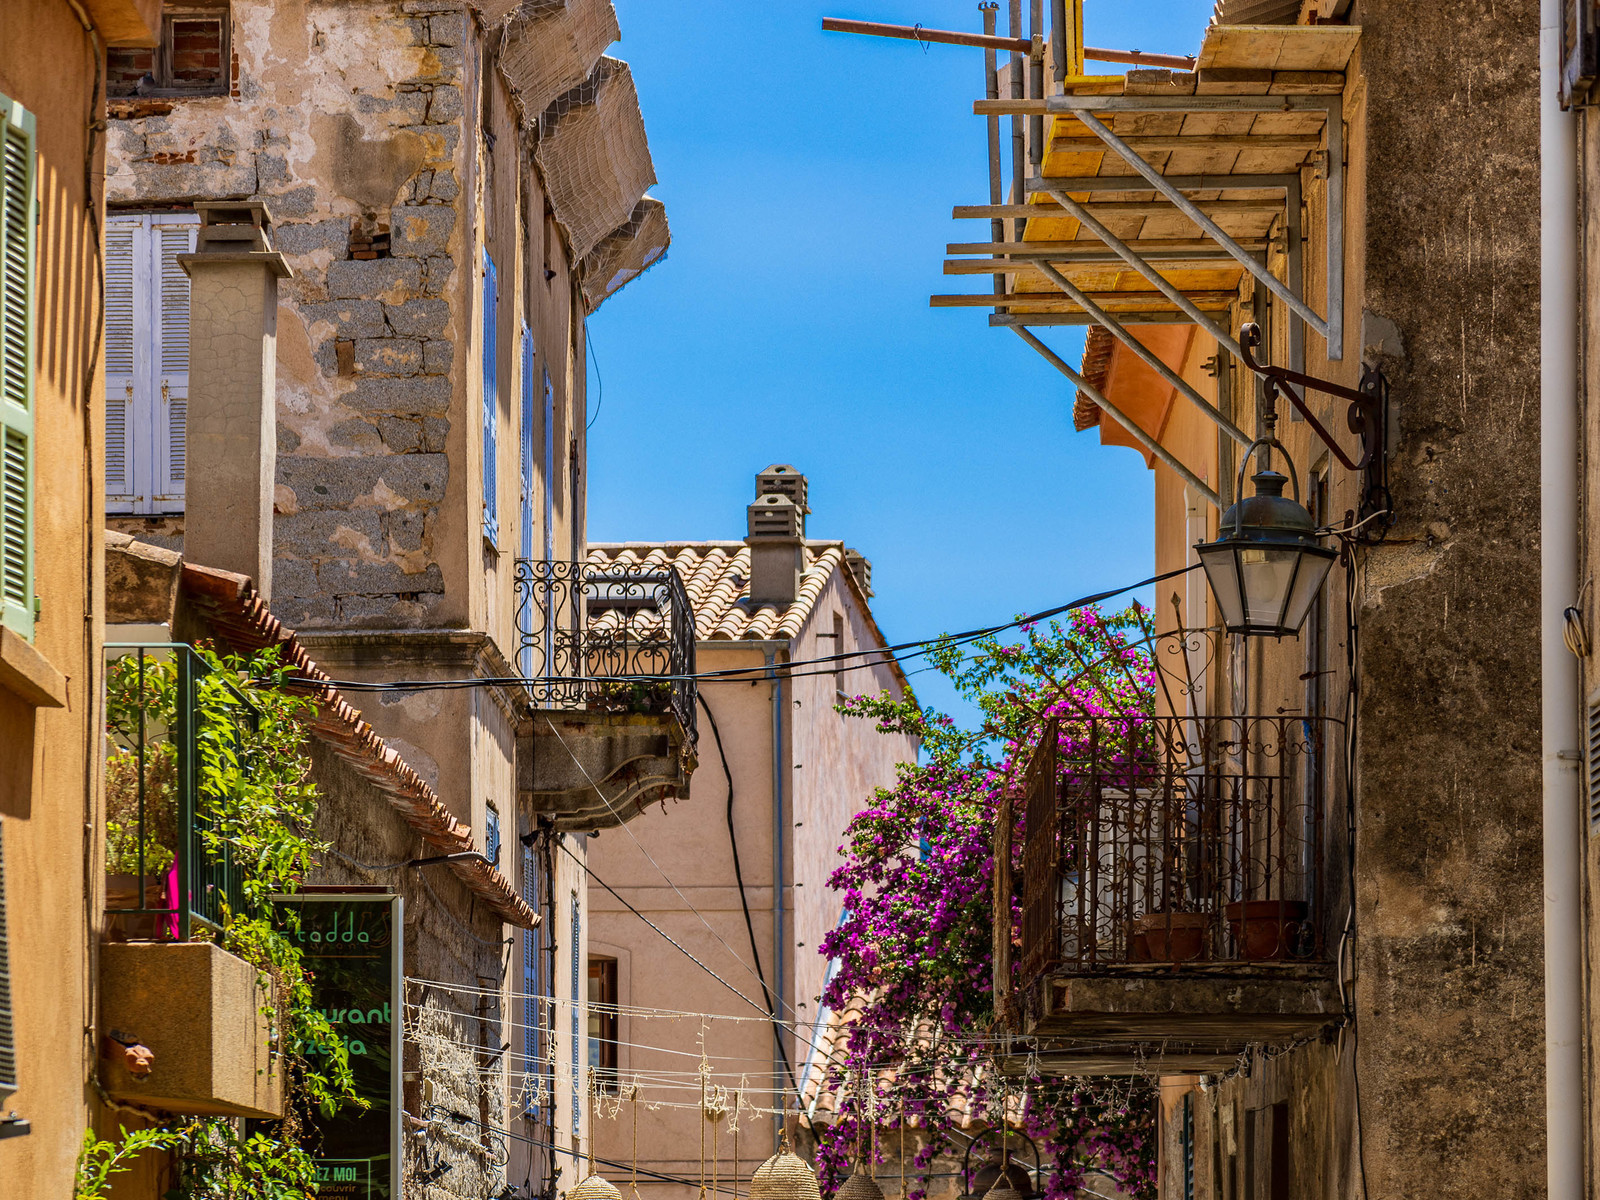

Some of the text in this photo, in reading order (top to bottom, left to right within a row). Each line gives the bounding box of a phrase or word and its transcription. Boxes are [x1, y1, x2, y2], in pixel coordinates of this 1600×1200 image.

[310, 1002, 391, 1024] urant
[333, 1167, 357, 1182] MOI
[320, 1184, 356, 1193] couvrir
